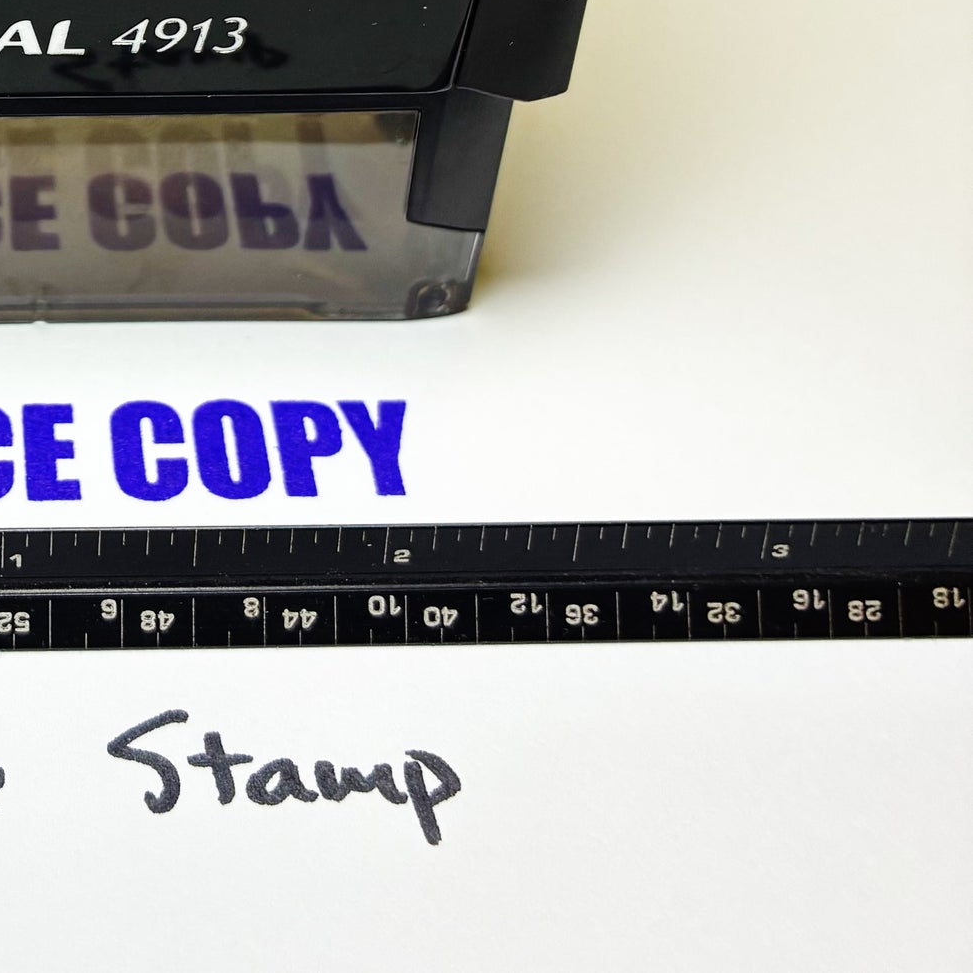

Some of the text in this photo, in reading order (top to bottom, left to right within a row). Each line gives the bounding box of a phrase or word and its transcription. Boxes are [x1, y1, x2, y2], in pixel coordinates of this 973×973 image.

[111, 16, 248, 54] 4913
[110, 399, 407, 502] COPY
[9, 553, 22, 568] 1
[393, 548, 411, 563] 2
[771, 544, 790, 558] 3
[100, 598, 118, 620] 6
[242, 596, 260, 619] 8
[367, 594, 402, 617] 10
[510, 592, 543, 615] 12
[650, 590, 685, 612] 14
[792, 588, 825, 610] 16
[932, 586, 965, 609] 18
[139, 609, 176, 632] 48
[281, 608, 318, 630] 44
[423, 605, 459, 628] 40
[565, 603, 599, 626] 36
[706, 601, 741, 624] 32
[847, 599, 882, 622] 28
[106, 709, 463, 846] Stamp
